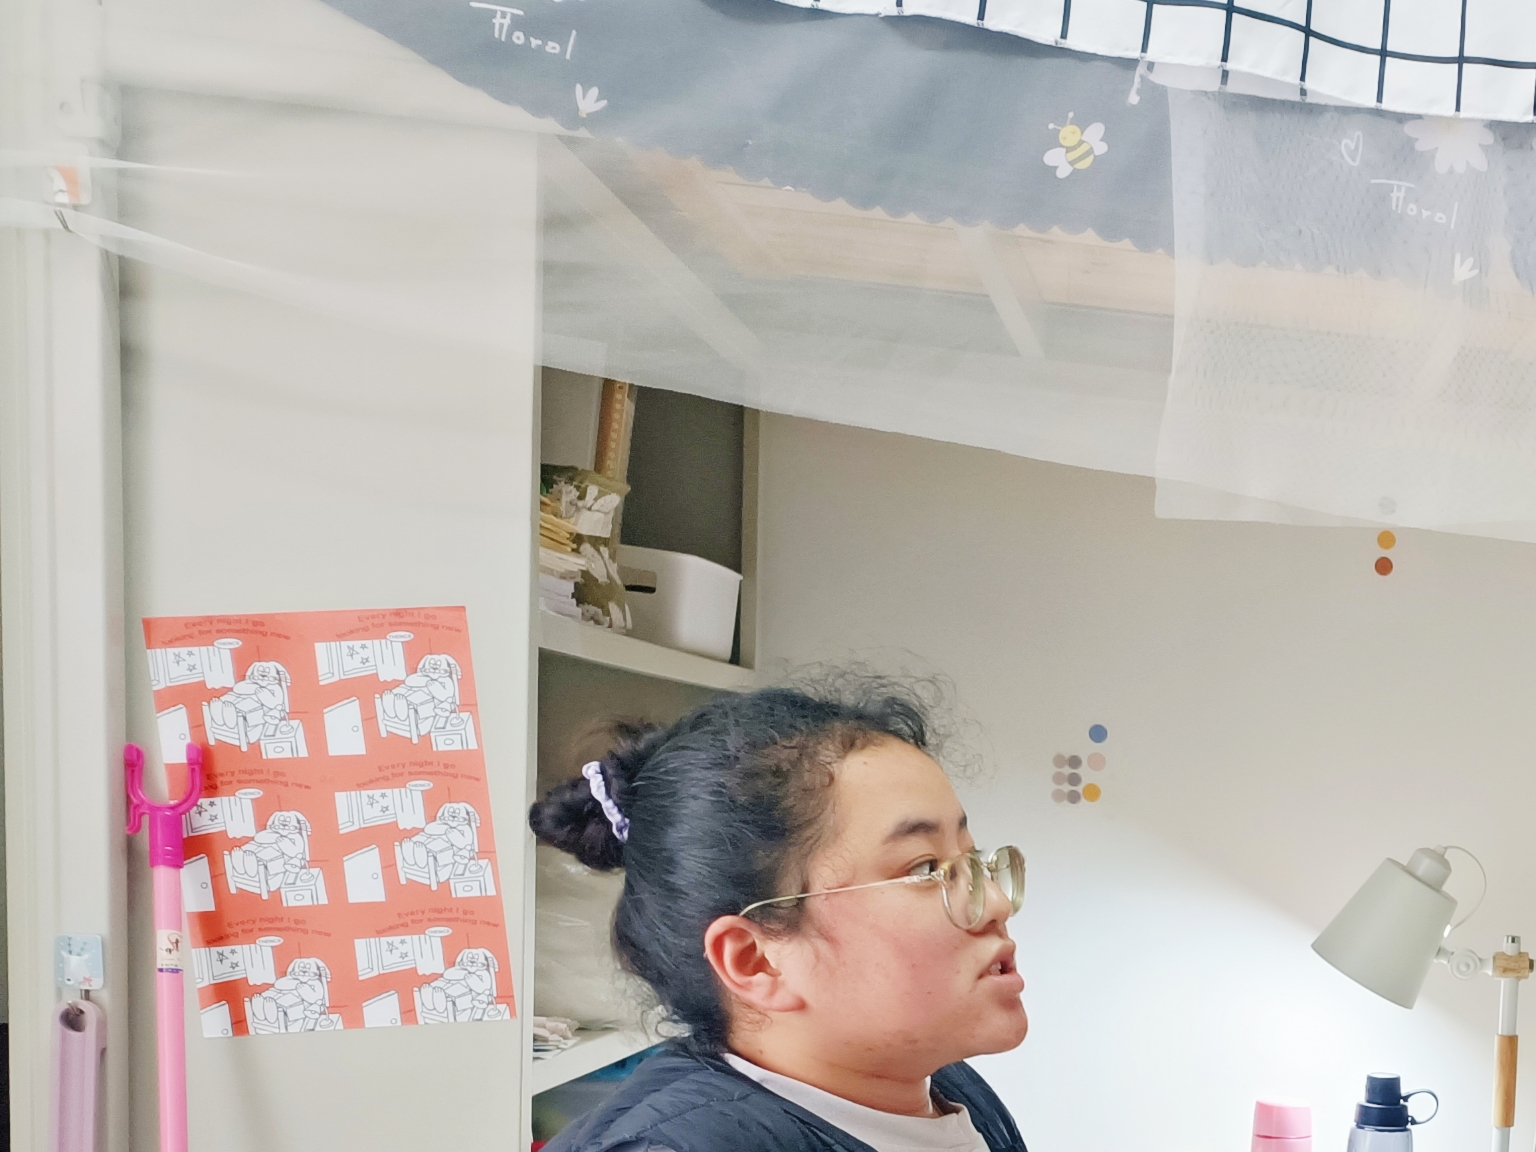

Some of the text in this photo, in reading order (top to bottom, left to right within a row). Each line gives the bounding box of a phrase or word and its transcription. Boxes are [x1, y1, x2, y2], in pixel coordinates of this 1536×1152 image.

[358, 613, 386, 622] Every
[389, 610, 414, 618] night
[388, 621, 440, 630] something
[378, 761, 406, 772] Every
[409, 760, 434, 768] night
[443, 762, 456, 770] go
[238, 768, 264, 776] night
[408, 770, 458, 779] something
[397, 908, 426, 919] Every
[428, 907, 453, 915] night
[258, 916, 284, 924] night
[427, 916, 478, 925] something
[257, 926, 309, 935] something
